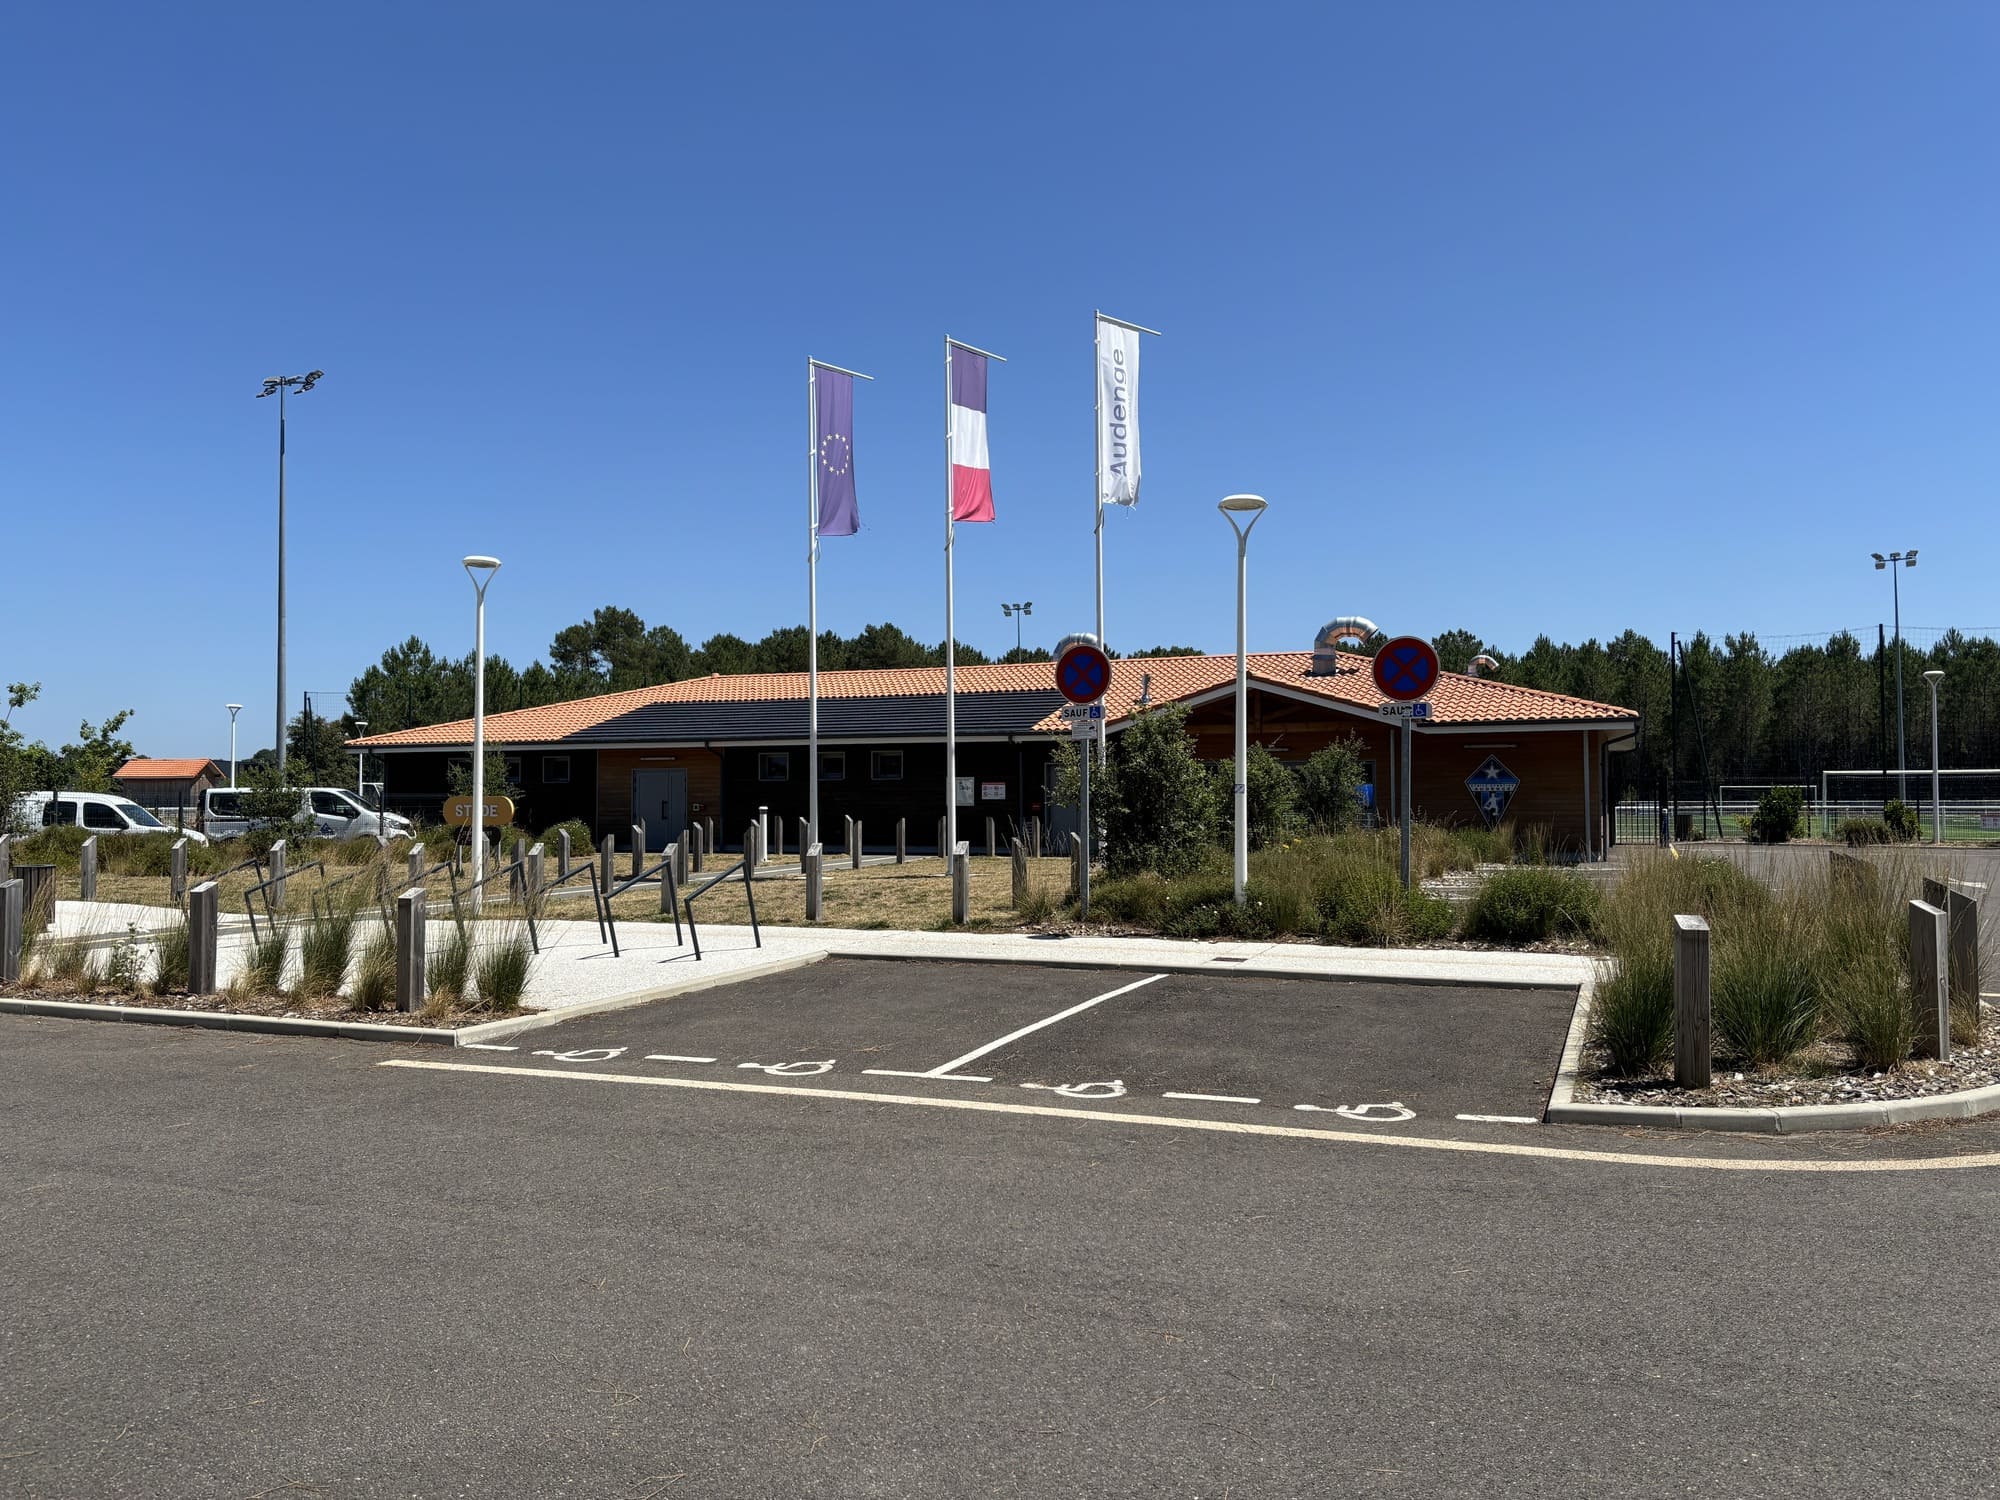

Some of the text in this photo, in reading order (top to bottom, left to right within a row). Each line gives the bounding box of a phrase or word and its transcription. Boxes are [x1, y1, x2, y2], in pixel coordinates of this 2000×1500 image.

[1110, 348, 1128, 477] Audenge
[1064, 709, 1088, 718] SAUF
[1382, 706, 1412, 716] SAU
[455, 804, 498, 817] STDE
